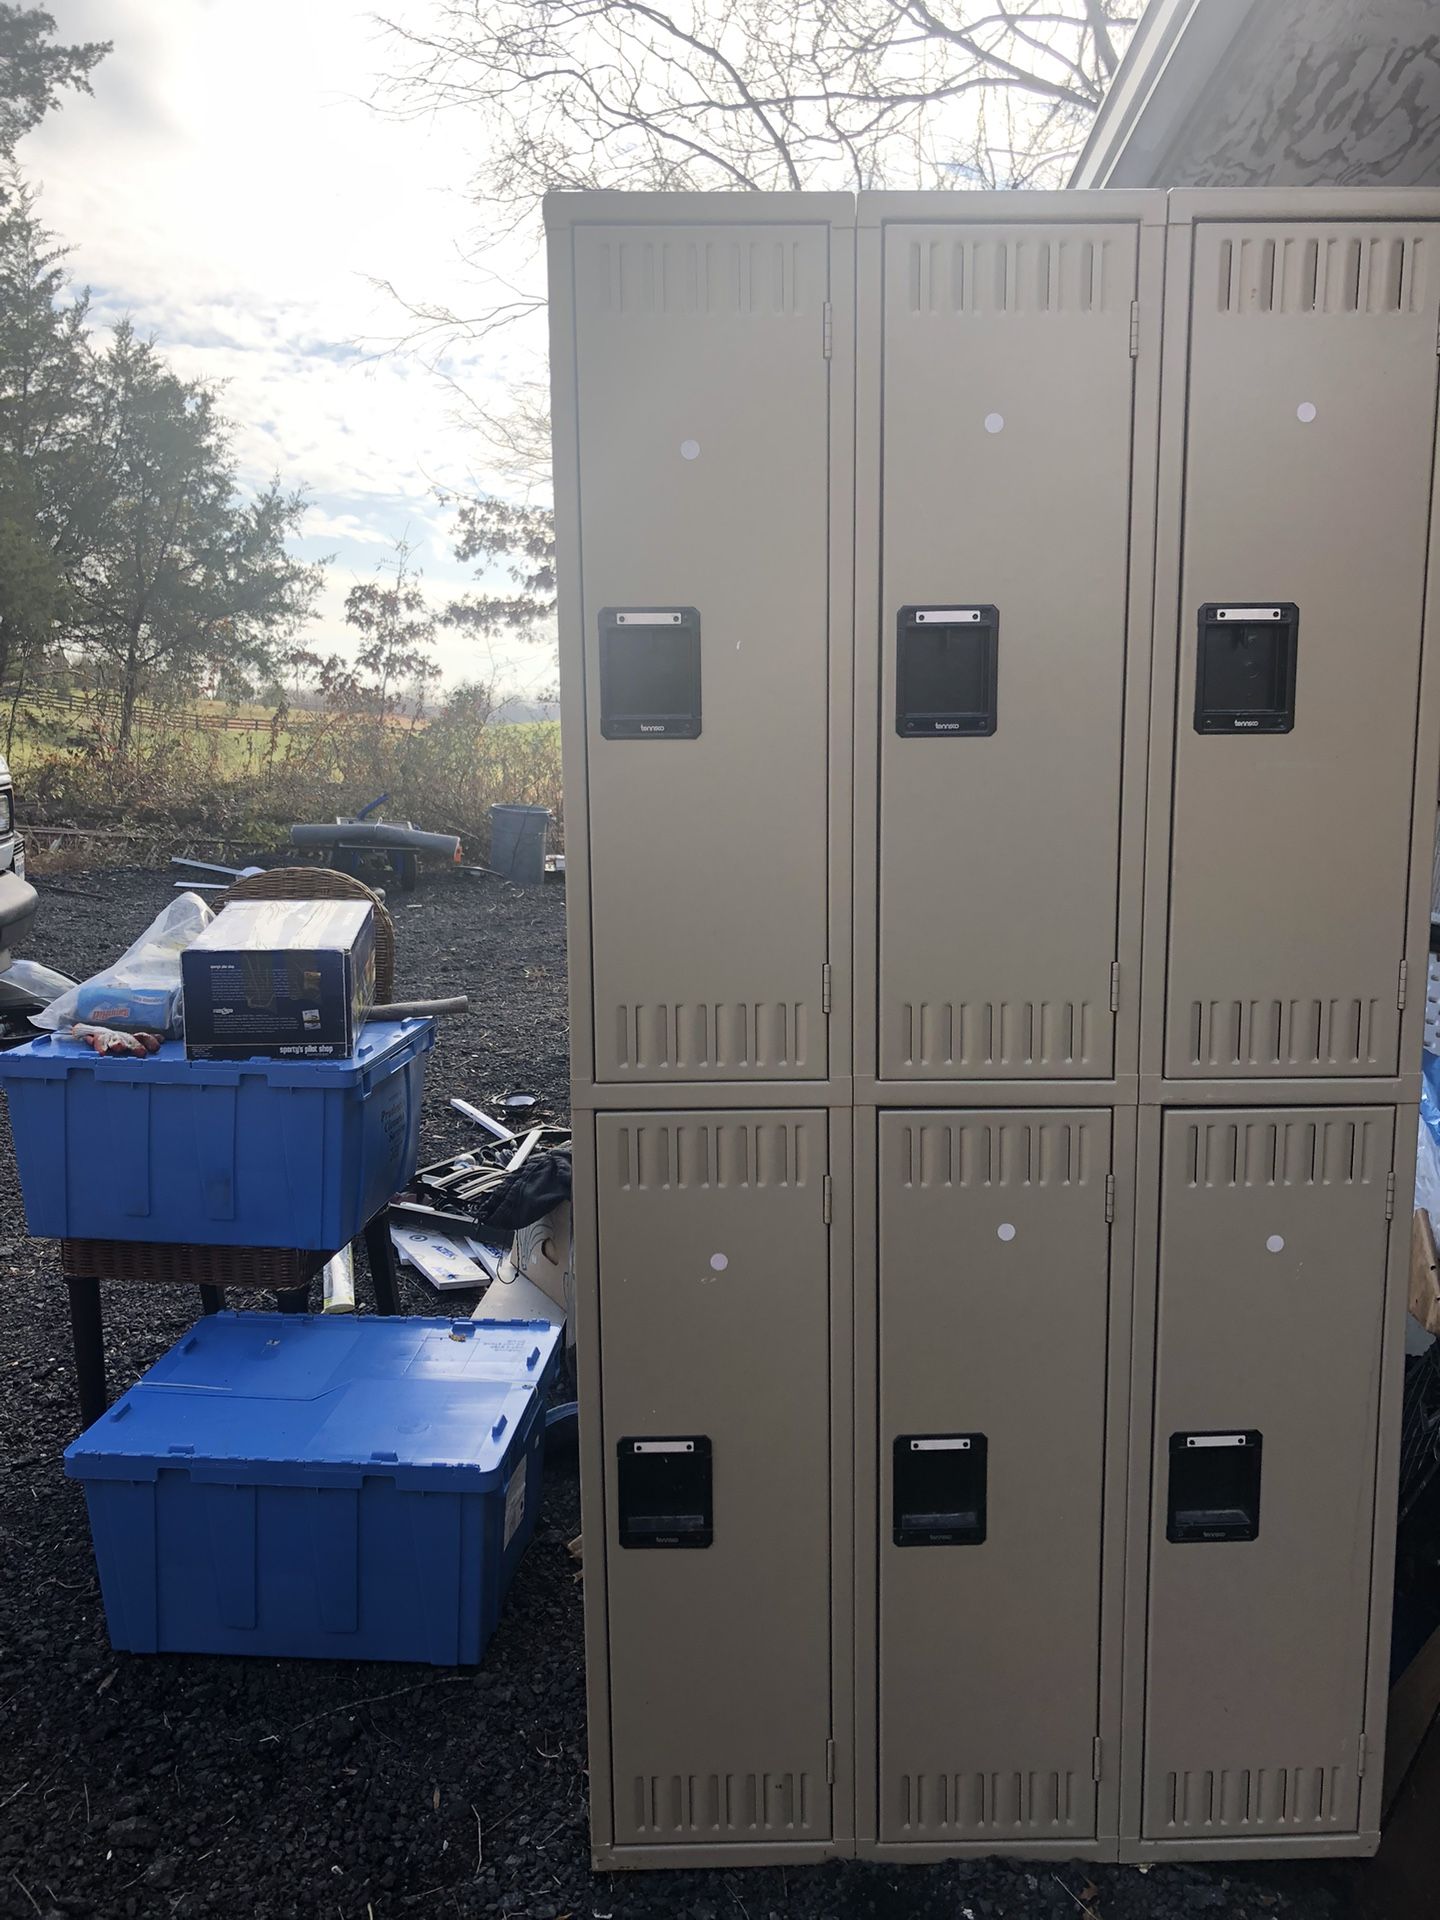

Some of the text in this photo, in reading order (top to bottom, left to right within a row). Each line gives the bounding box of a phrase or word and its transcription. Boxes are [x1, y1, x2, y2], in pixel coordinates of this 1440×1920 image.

[280, 1044, 333, 1055] sporty's pilot shop
